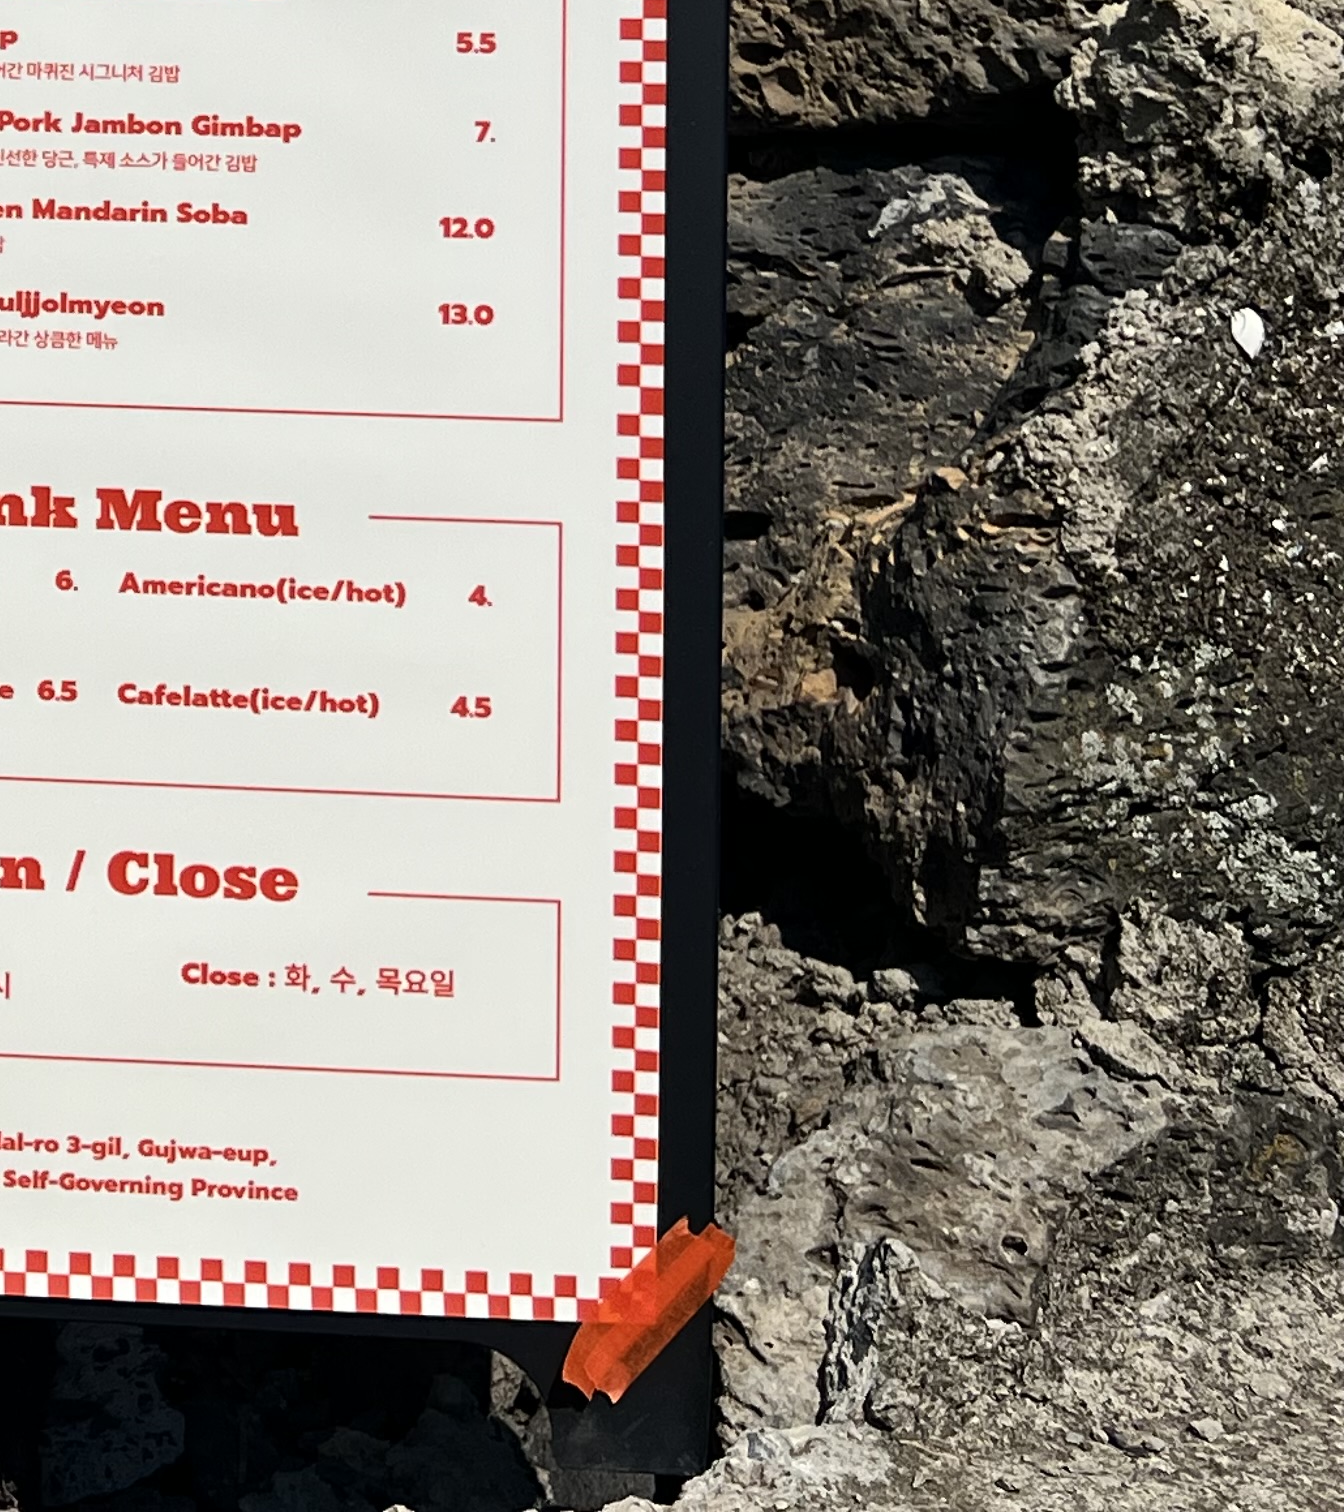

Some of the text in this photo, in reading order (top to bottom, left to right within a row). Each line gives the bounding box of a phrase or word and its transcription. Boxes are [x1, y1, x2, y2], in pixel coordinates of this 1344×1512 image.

[456, 32, 497, 54] 5.5
[27, 62, 74, 81] 마퀴진
[79, 64, 143, 82] 시그니처
[149, 65, 180, 83] 김밥
[71, 112, 182, 135] Jambon
[191, 114, 302, 144] Gimbap
[475, 121, 495, 142] 7.
[42, 150, 78, 168] 당근,
[83, 151, 115, 169] 특제
[119, 152, 168, 170] 소스가
[172, 153, 221, 171] 들어간
[226, 155, 258, 173] 김밥
[32, 198, 168, 223] Mandarin
[177, 202, 248, 225] Soba
[439, 217, 495, 239] 12.0
[438, 303, 494, 326] 13.0
[34, 330, 82, 349] 상큼한
[86, 331, 118, 350] 메뉴
[96, 488, 299, 537] Menu
[55, 570, 78, 591] 6.
[118, 572, 406, 608] Americano(ice/hot)
[468, 585, 492, 606] 4.
[37, 680, 78, 702] 6.5
[118, 683, 379, 719] Cafelatte(ice/hot)
[450, 696, 492, 718] 4.5
[66, 850, 86, 892] /
[107, 850, 299, 902] Close
[181, 962, 260, 987] Close
[285, 963, 320, 994] 화,
[330, 966, 366, 996] 수,
[376, 968, 454, 997] 목요일
[67, 1135, 130, 1160] 3-gil,
[138, 1139, 277, 1167] Gujwa-eup,
[3, 1169, 183, 1201] Self-Governing
[191, 1178, 298, 1201] Province
